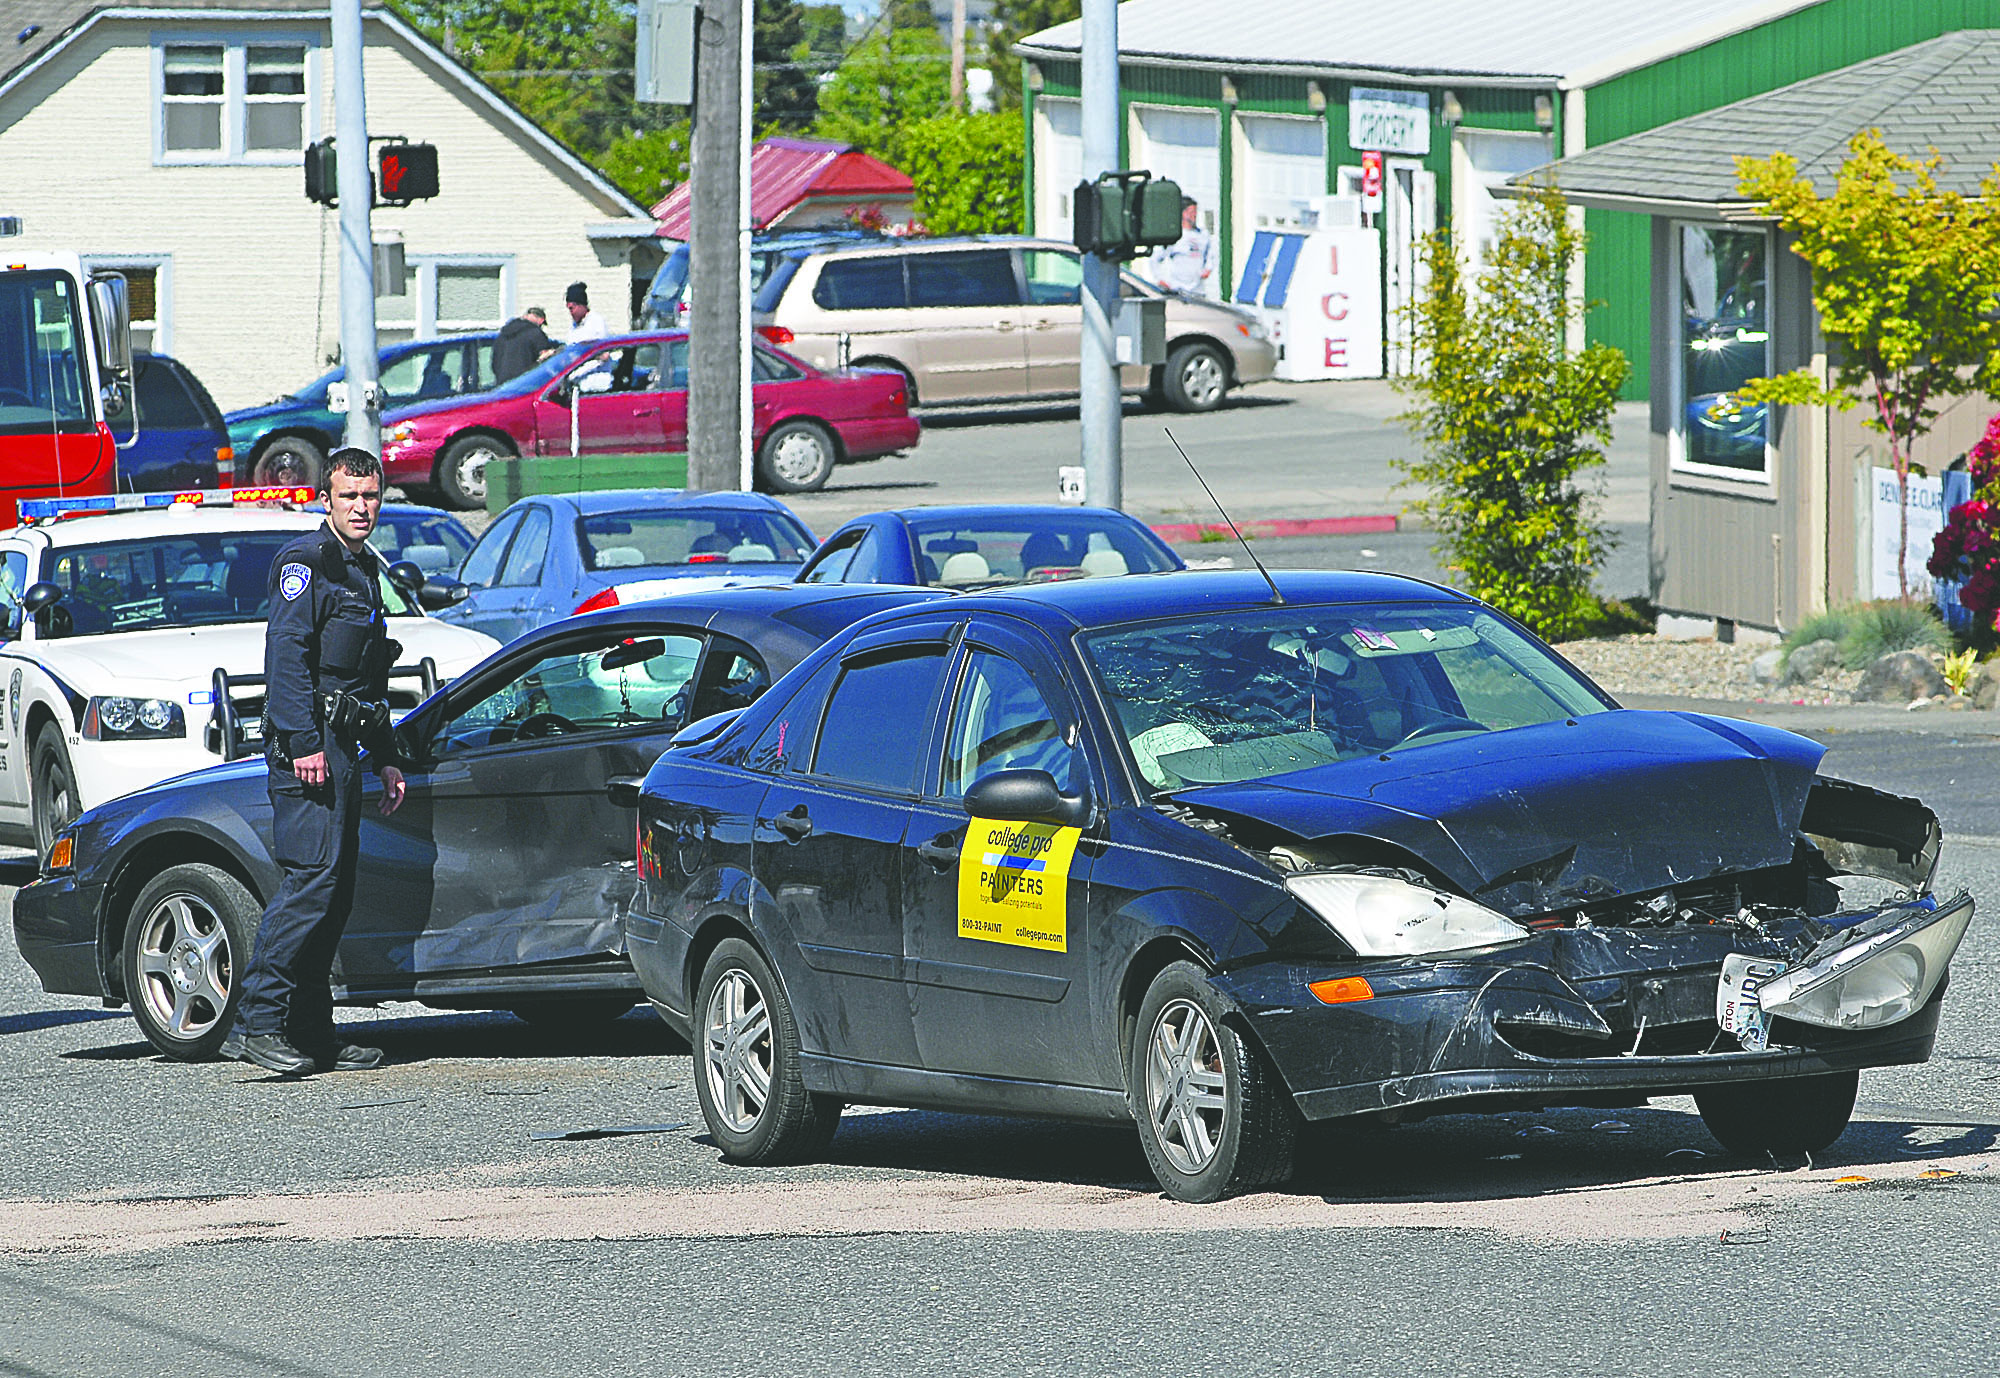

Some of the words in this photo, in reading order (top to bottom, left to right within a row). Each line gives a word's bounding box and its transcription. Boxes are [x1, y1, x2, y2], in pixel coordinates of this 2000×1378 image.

[1321, 245, 1349, 367] ICE
[988, 826, 1030, 854] college
[1029, 835, 1053, 856] pro
[980, 871, 1043, 896] PAINTERS
[961, 918, 1003, 934] 800-32-PAINT
[1015, 926, 1063, 943] collegepro.com
